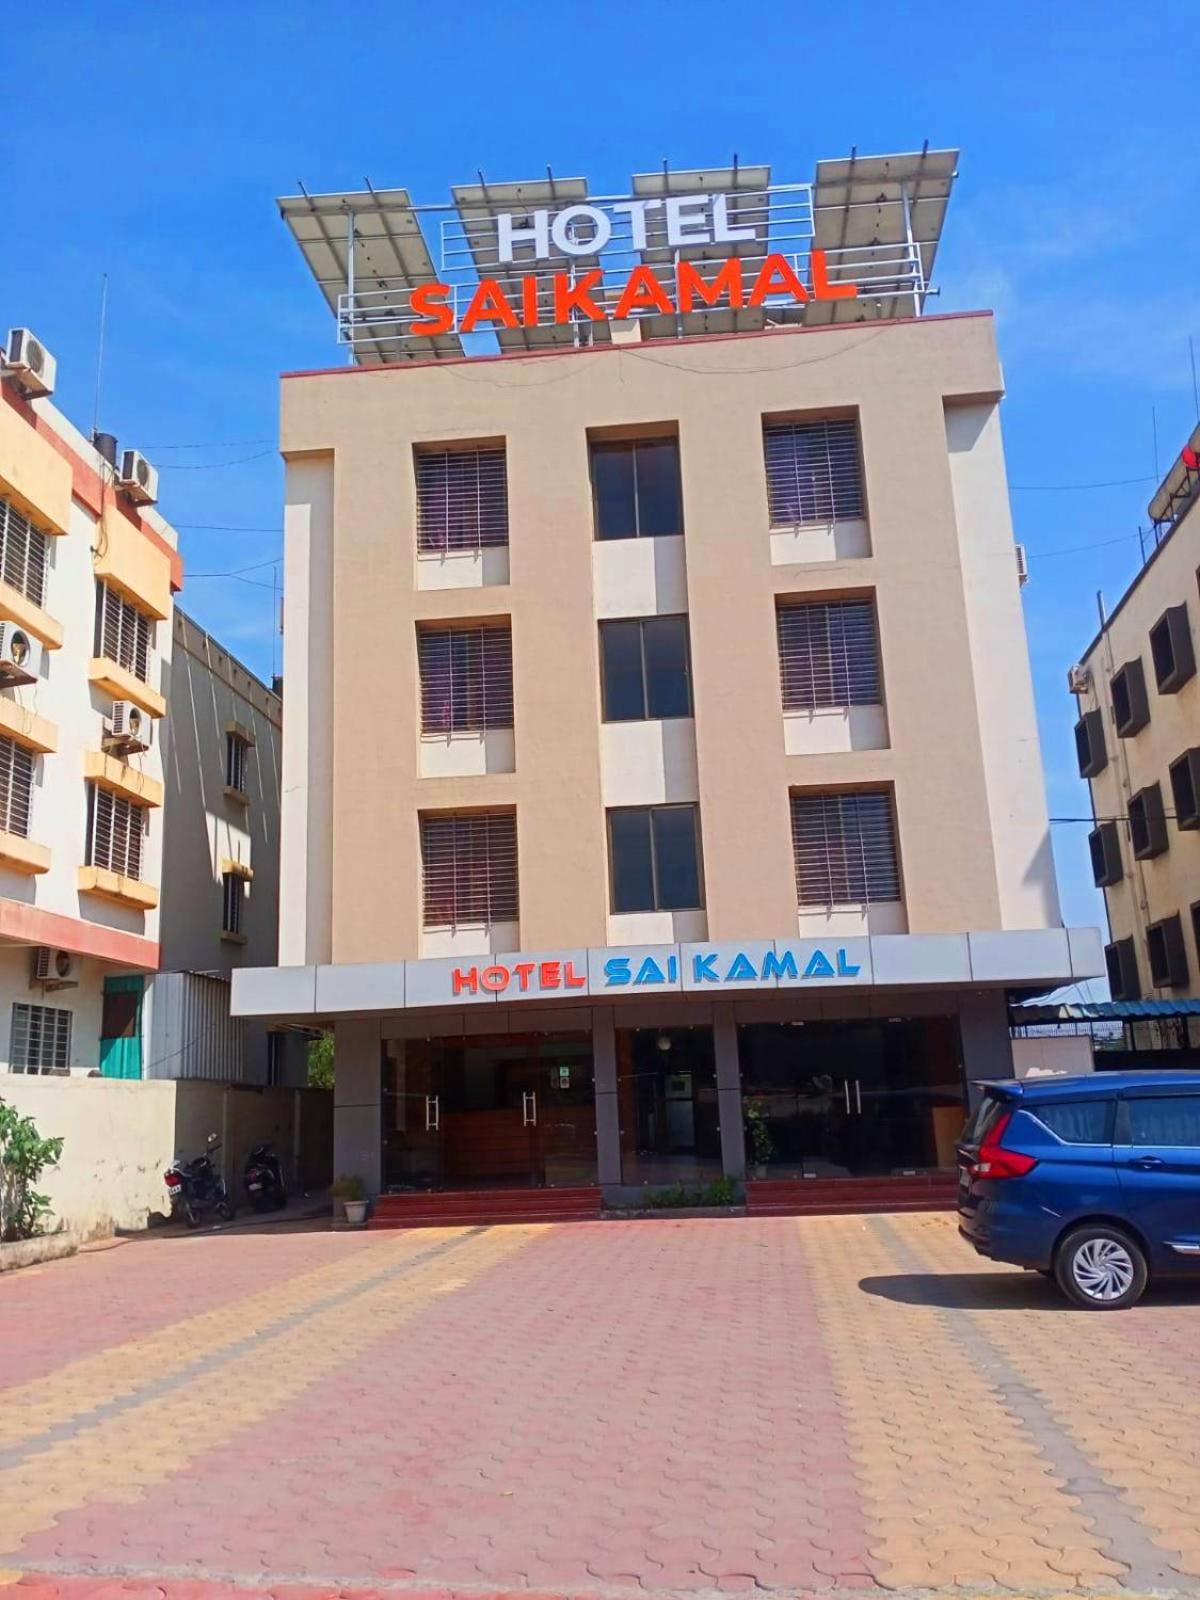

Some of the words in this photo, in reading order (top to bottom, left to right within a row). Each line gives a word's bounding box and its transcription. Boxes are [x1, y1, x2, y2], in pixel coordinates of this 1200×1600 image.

[498, 193, 756, 262] HOTEL
[452, 961, 587, 993] HOTEL
[603, 955, 678, 985] SAI
[693, 948, 861, 980] KAMAL
